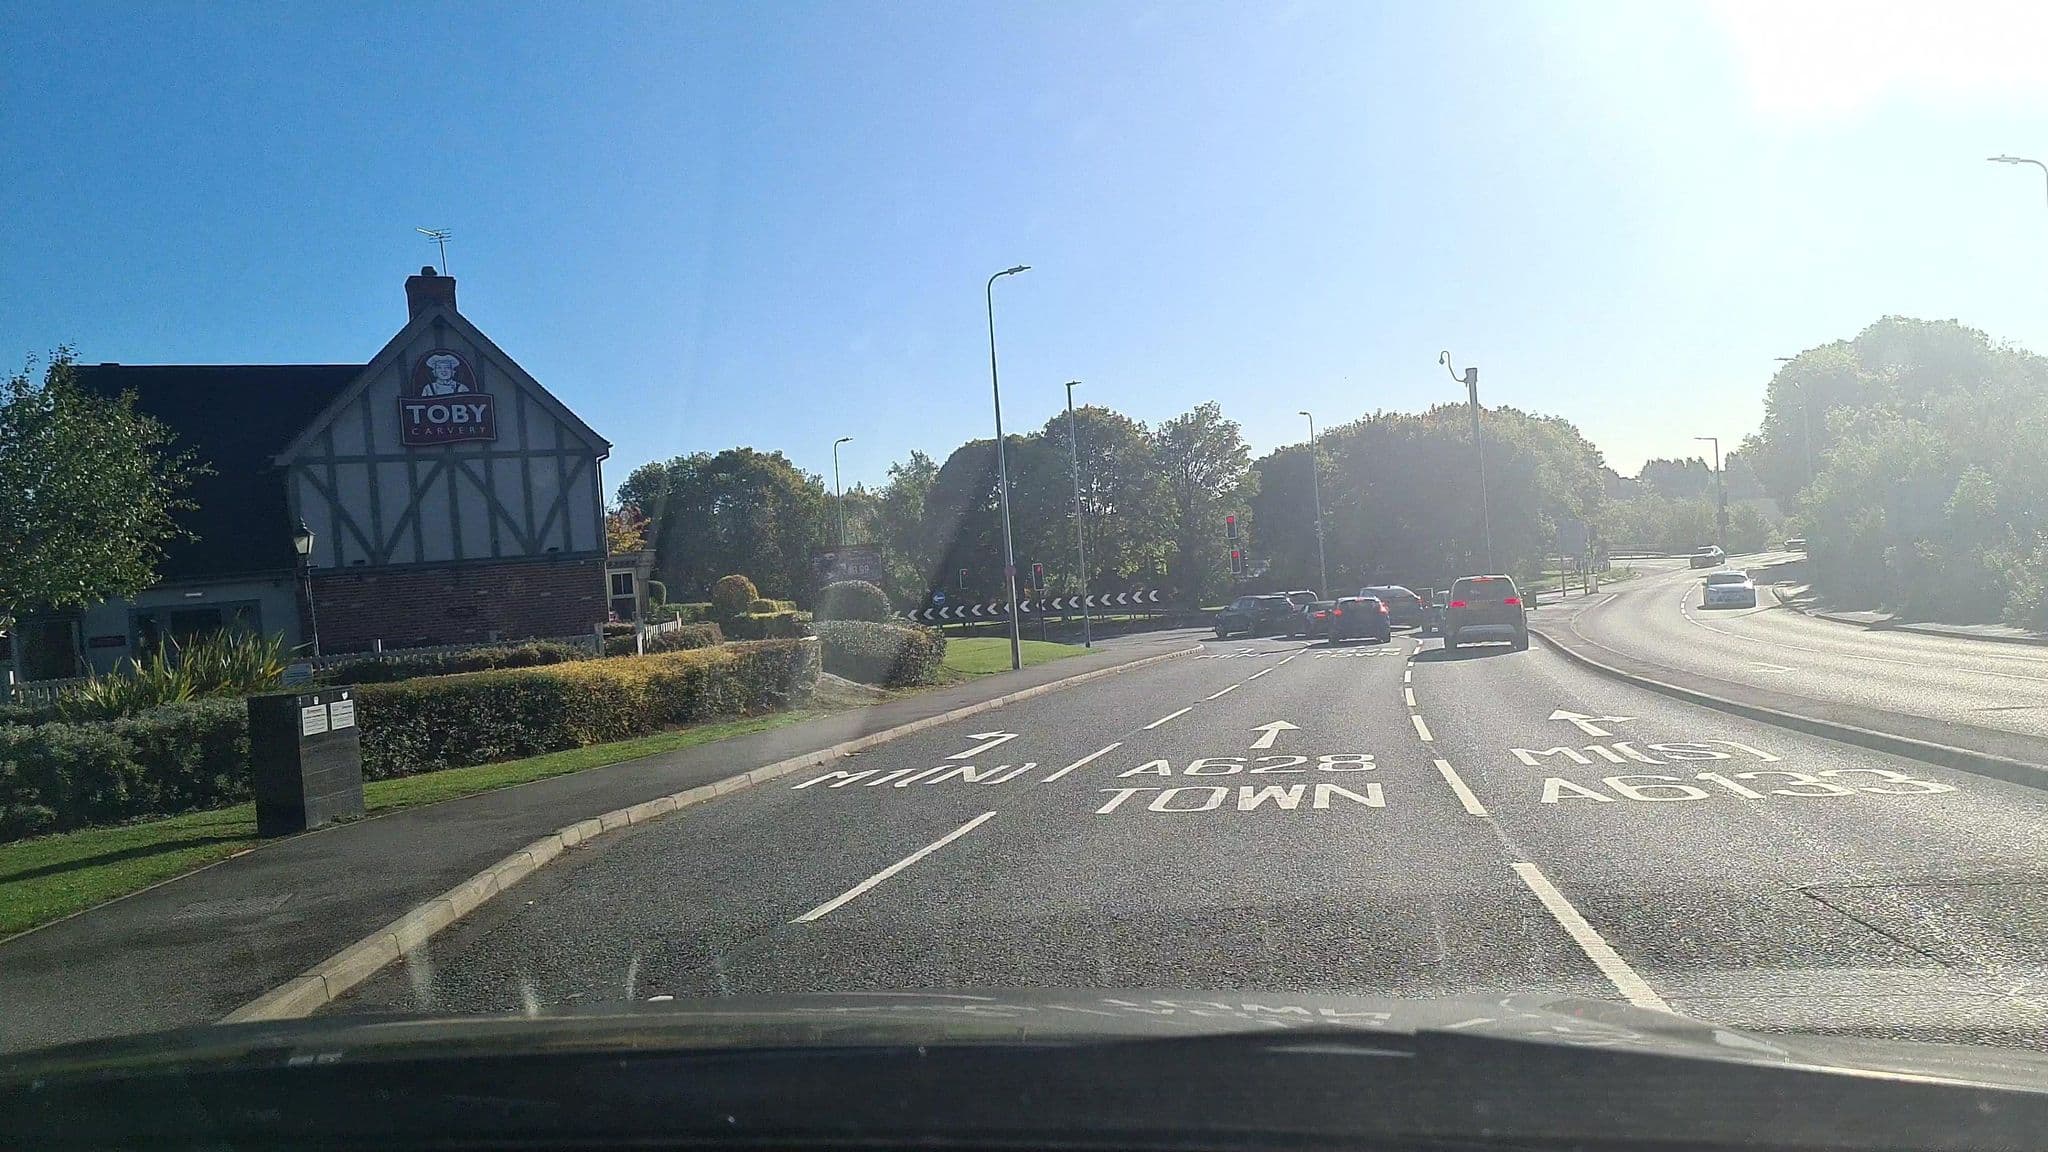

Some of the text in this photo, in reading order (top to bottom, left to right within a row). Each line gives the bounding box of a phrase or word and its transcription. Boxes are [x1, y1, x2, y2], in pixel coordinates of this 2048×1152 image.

[406, 405, 487, 424] TOBY
[1117, 754, 1376, 777] A628
[1095, 783, 1386, 813] TOWN
[1541, 770, 1956, 803] A6133
